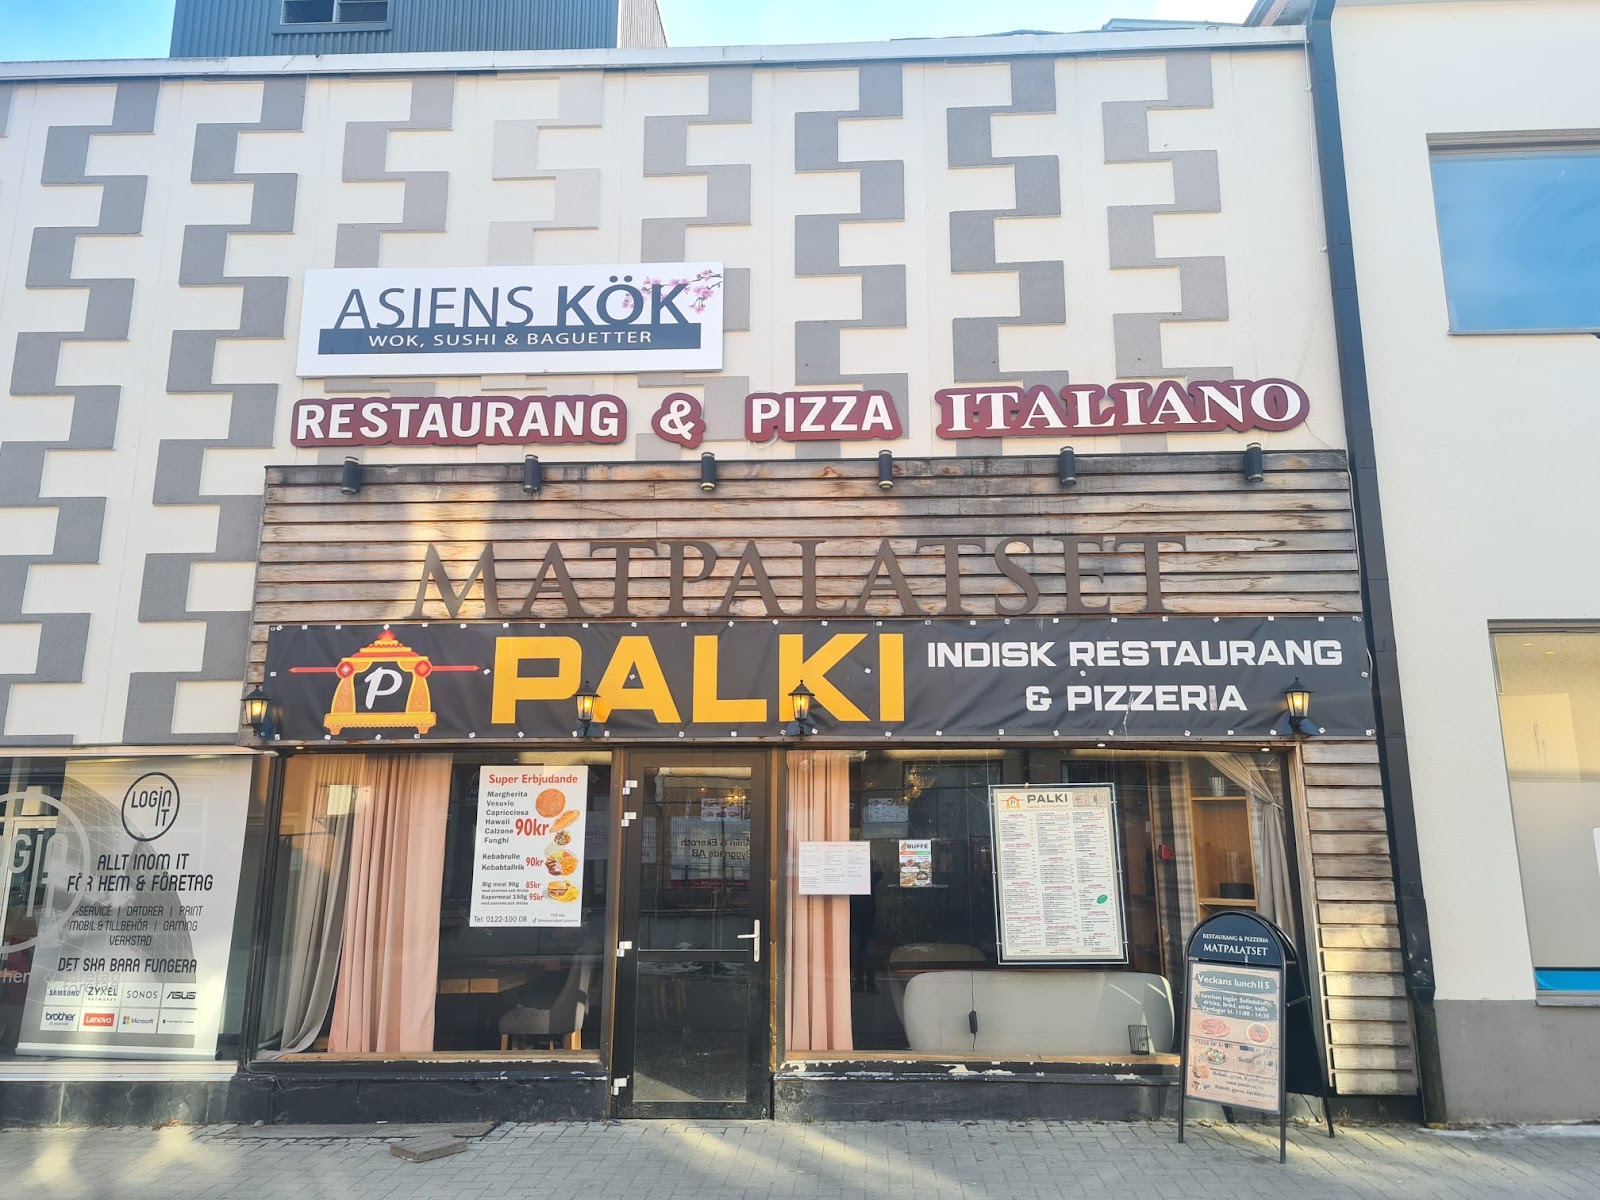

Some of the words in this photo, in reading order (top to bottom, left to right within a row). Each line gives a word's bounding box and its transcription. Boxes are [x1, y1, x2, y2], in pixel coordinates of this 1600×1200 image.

[332, 286, 534, 329] ASIENS
[558, 275, 690, 326] KÖK
[368, 333, 425, 348] WOK,
[433, 333, 496, 346] SUSHI
[504, 333, 518, 346] &
[527, 331, 652, 345] BAGUETTER
[296, 400, 619, 440] RESTAURANG
[659, 399, 695, 440] &
[752, 395, 894, 433] PIZZA
[946, 383, 1302, 432] ITALIANO
[411, 534, 1188, 620] MATPALATSET
[927, 641, 1057, 668] INDISK
[1069, 640, 1343, 667] RESTAURANG
[491, 633, 905, 724] PALKI
[364, 666, 403, 710] P
[1026, 686, 1052, 712] &
[1067, 685, 1247, 712] PIZZERIA
[488, 774, 519, 786] Super
[522, 774, 578, 786] Erbjudande
[1027, 794, 1068, 803] PALKI
[516, 818, 550, 836] 90kr
[484, 836, 509, 844] Funghi
[97, 854, 129, 870] ALLT
[133, 854, 171, 870] INOM
[176, 853, 190, 870] IT
[526, 857, 544, 866] 90kr
[98, 875, 131, 891] HEM
[136, 875, 146, 891] &
[151, 872, 214, 891] FÖRETAG
[126, 906, 164, 917] DATORER
[179, 906, 203, 916] PRINT
[69, 921, 96, 931] MOBIL
[105, 919, 148, 931] TILLBEHÖR
[163, 920, 198, 932] GAMING
[110, 935, 152, 946] VERKSTAD
[1202, 933, 1238, 942] RESTAURANG
[1203, 943, 1268, 956] MATPALATSET
[58, 958, 80, 972] DET
[82, 958, 106, 972] SKA
[110, 958, 140, 972] BARA
[144, 959, 196, 974] FUNGERA
[1197, 974, 1232, 986] Veckans
[1234, 978, 1256, 988] lunch
[88, 987, 118, 996] ZYXEL
[126, 990, 158, 998] SONOS
[166, 992, 196, 1000] ASUS
[45, 1012, 76, 1022] brother
[85, 1016, 112, 1024] Lenovo
